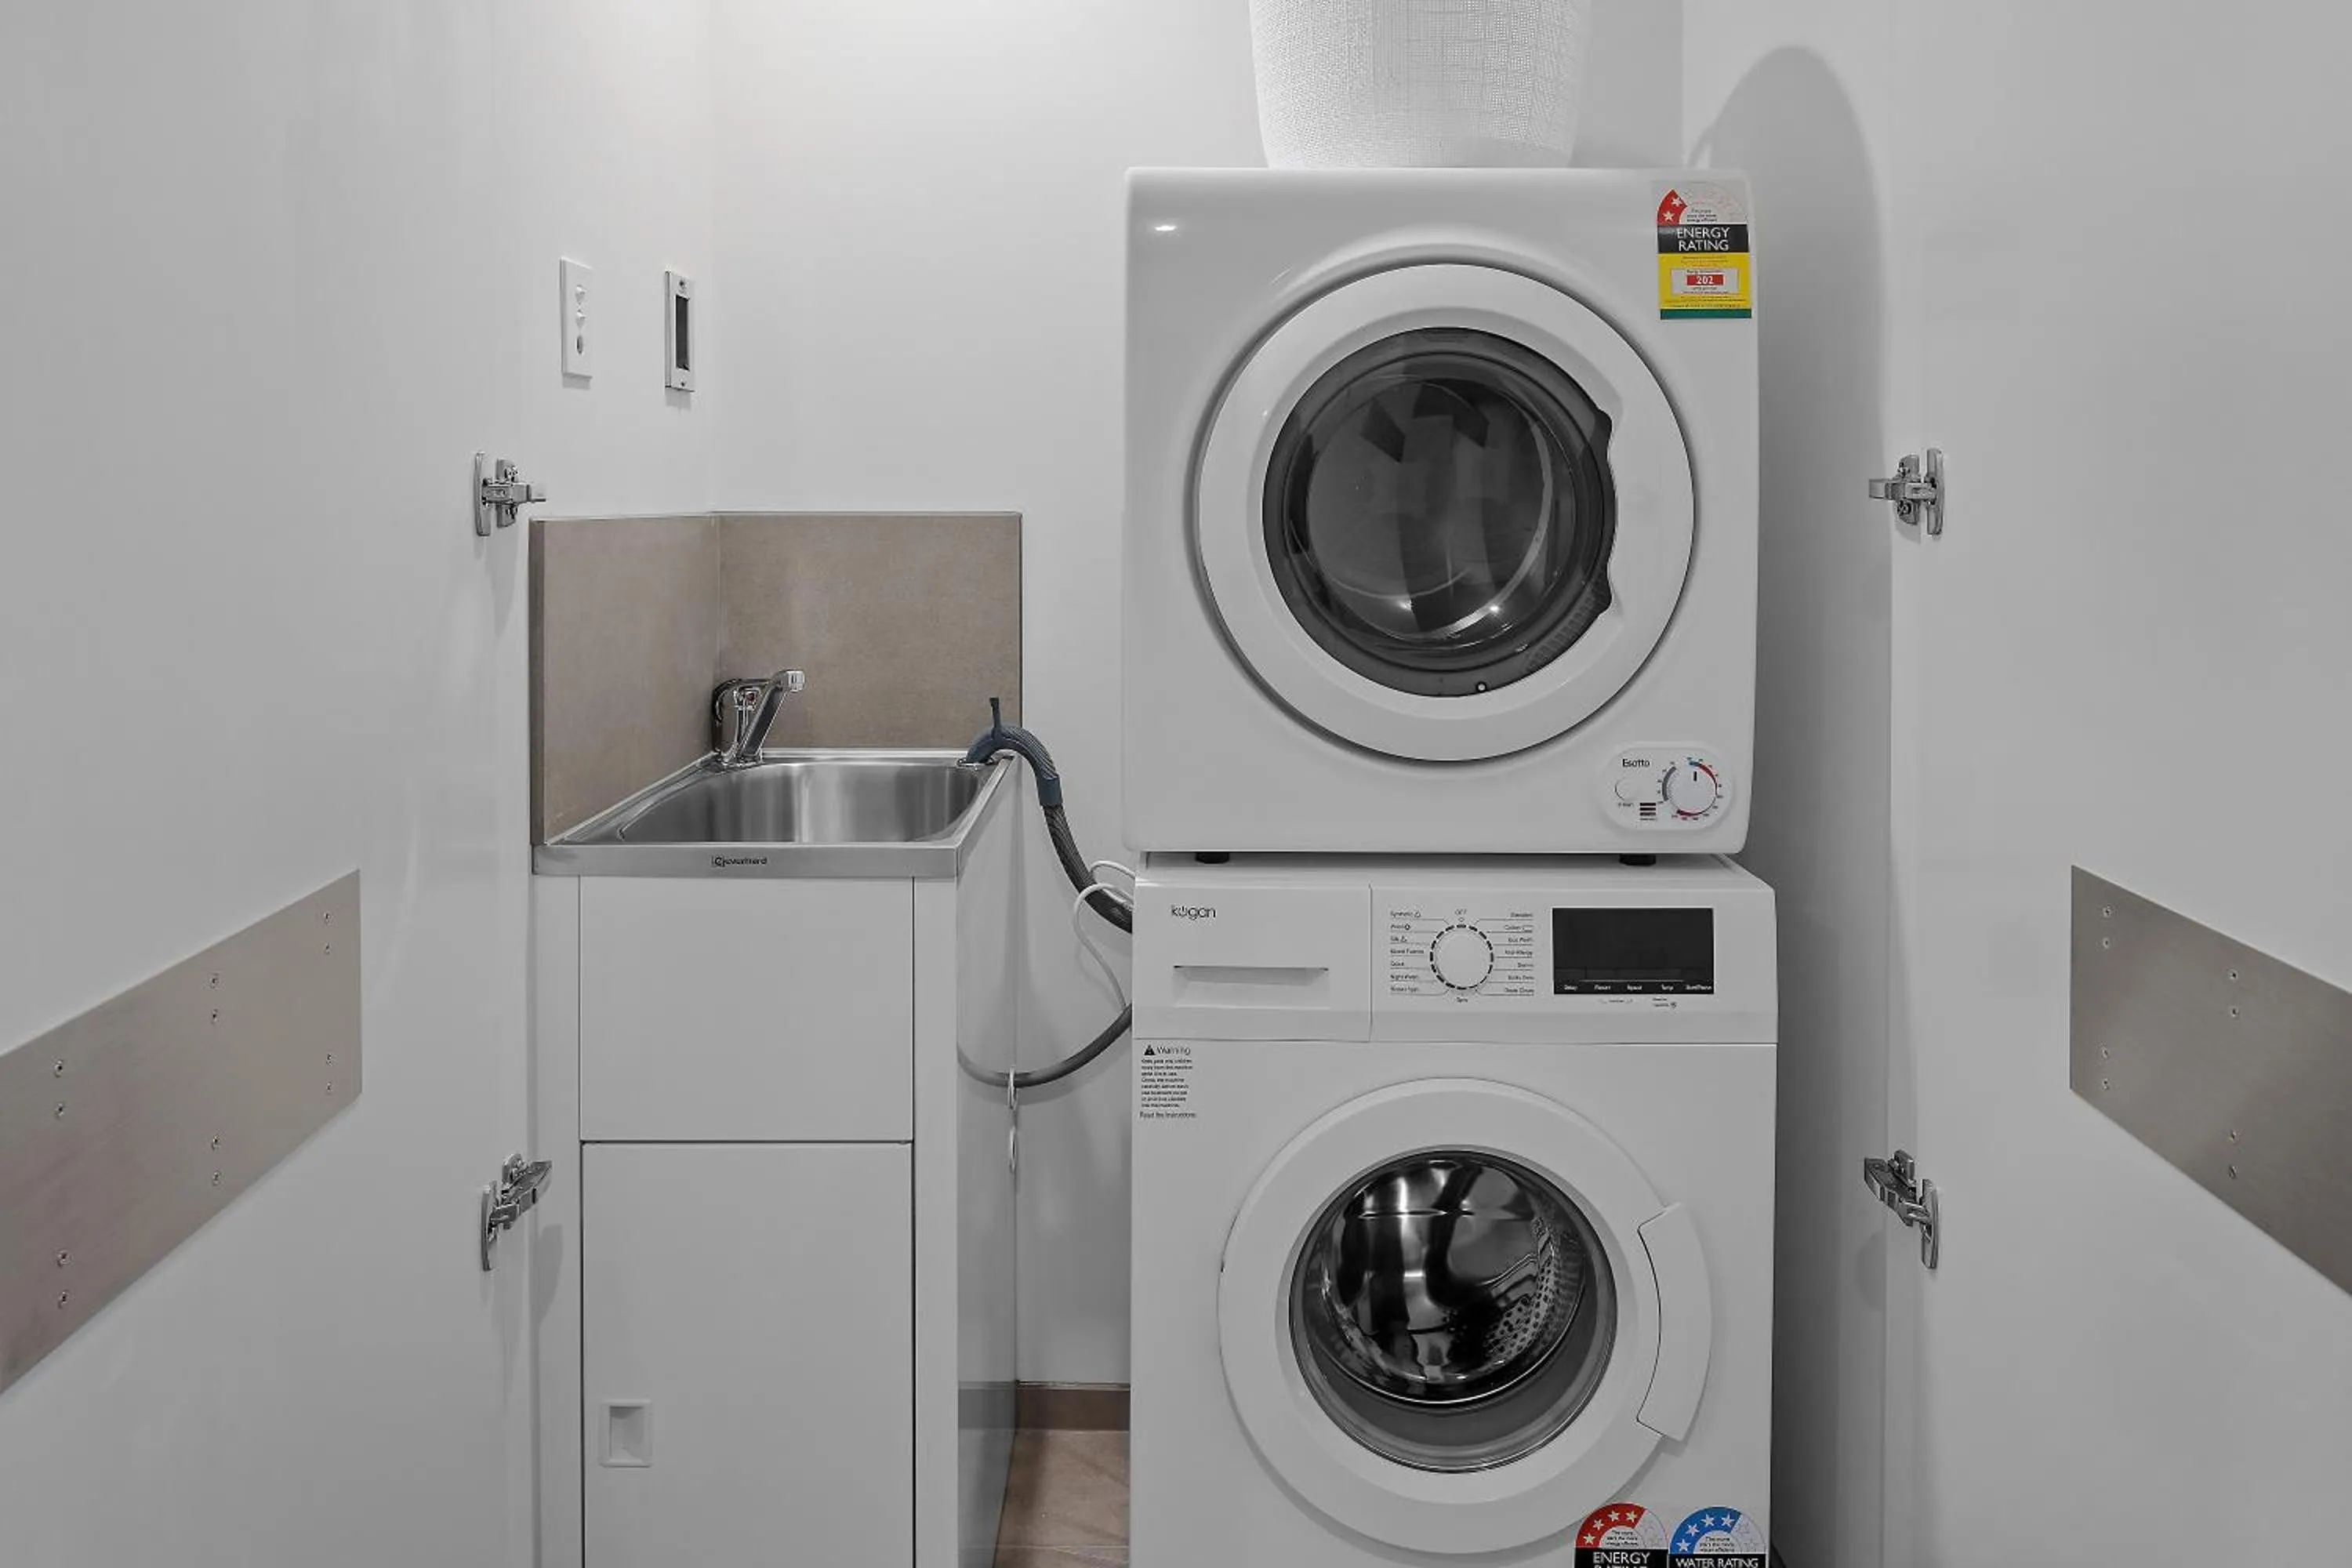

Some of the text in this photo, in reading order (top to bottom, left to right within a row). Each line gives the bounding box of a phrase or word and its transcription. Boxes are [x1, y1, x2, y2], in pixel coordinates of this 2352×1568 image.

[1677, 227, 1730, 238] ENERGY
[1679, 240, 1730, 252] RATING
[1696, 275, 1714, 285] 202
[1171, 904, 1216, 921] kogan
[1156, 1047, 1191, 1056] Warning
[1593, 1552, 1650, 1564] ENERGY
[1675, 1558, 1759, 1568] WATER RATING
